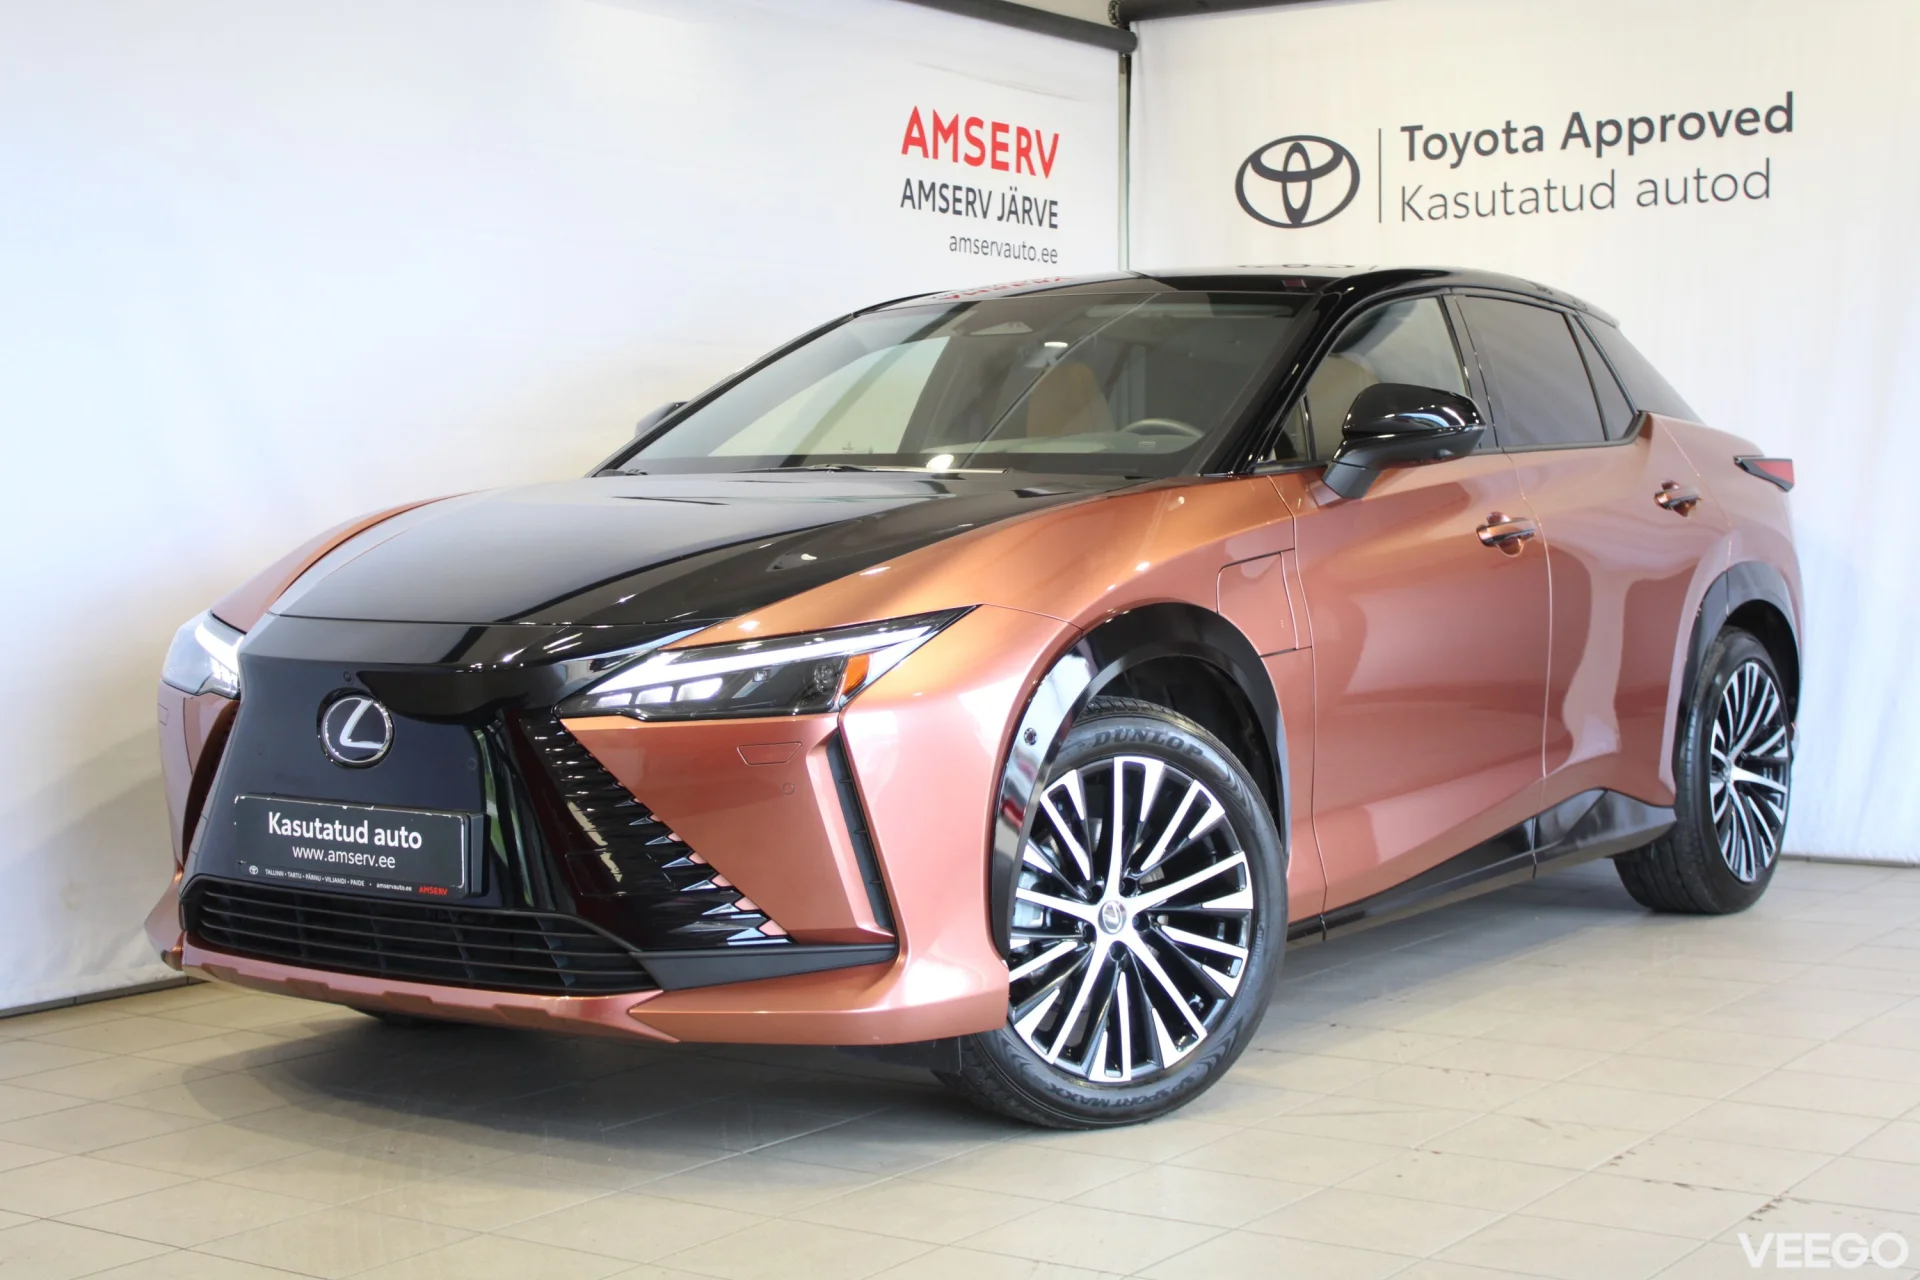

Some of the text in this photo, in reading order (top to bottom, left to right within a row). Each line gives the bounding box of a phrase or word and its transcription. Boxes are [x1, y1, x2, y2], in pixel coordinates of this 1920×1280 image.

[901, 105, 1059, 179] AMSERV
[1400, 91, 1794, 169] Toyota Approved
[900, 178, 1058, 229] AMSERV JÄRVE
[1401, 158, 1770, 222] Kasutatud autod
[949, 235, 1058, 264] amservauto.ee
[1092, 728, 1204, 756] DUNLOP
[268, 811, 422, 849] Kasutatud auto
[292, 846, 396, 869] www.amserv.ee
[265, 868, 448, 895] TALLINN TARTU PÄRNU VILJANDI PAIDE amservauto.ee AMSERV
[1044, 1083, 1110, 1108] MAXX
[1109, 1089, 1170, 1108] SPORT
